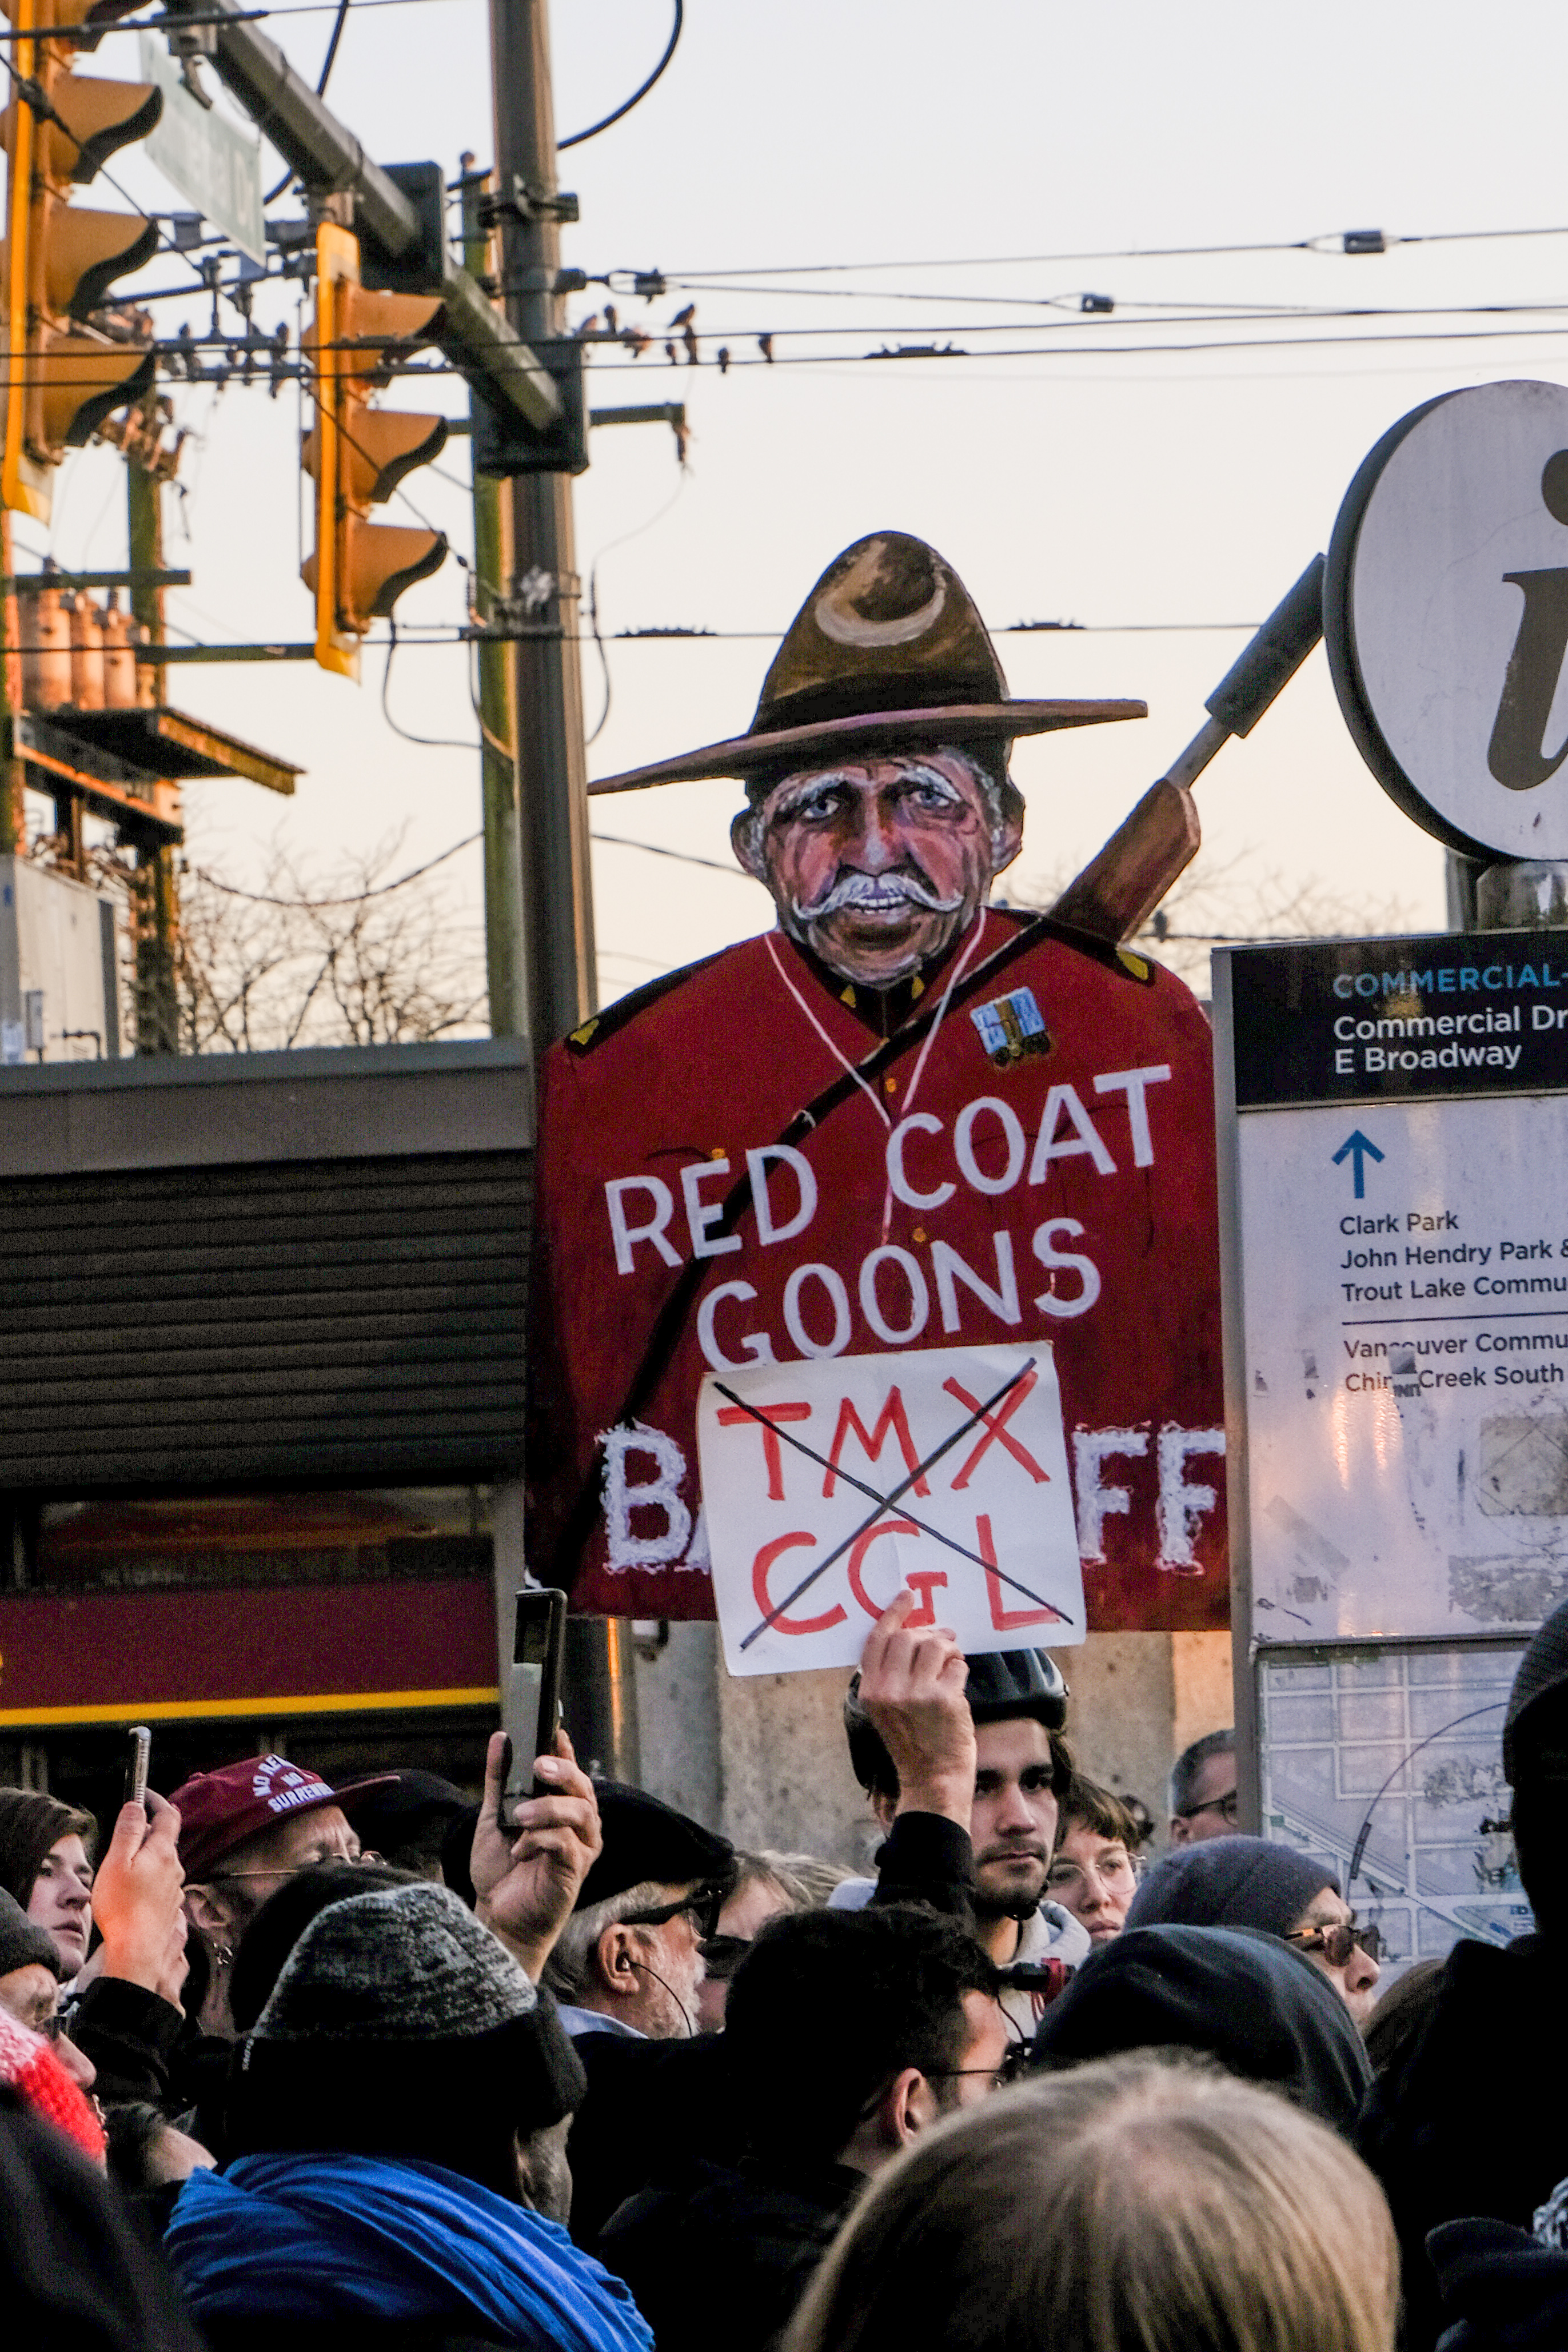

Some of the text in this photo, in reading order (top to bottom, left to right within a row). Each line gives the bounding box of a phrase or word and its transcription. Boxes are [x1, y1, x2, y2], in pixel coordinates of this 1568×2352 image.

[1334, 1005, 1521, 1041] Commercial
[1335, 1041, 1522, 1074] E Broadway
[604, 1063, 1172, 1275] RED COAT
[1340, 1210, 1459, 1235] Clark Park
[1340, 1248, 1397, 1269] John
[1405, 1243, 1491, 1265] Hendry
[1500, 1239, 1553, 1260] Park
[697, 1218, 1102, 1373] GOONS
[1341, 1276, 1567, 1301] Trout Lake Commu
[1343, 1333, 1568, 1358] Vanuver Commu
[1418, 1367, 1487, 1388] Creek
[1494, 1364, 1565, 1385] South
[717, 1370, 1050, 1500] TMX
[752, 1514, 1062, 1635] CGL
[253, 1775, 272, 1796] NO
